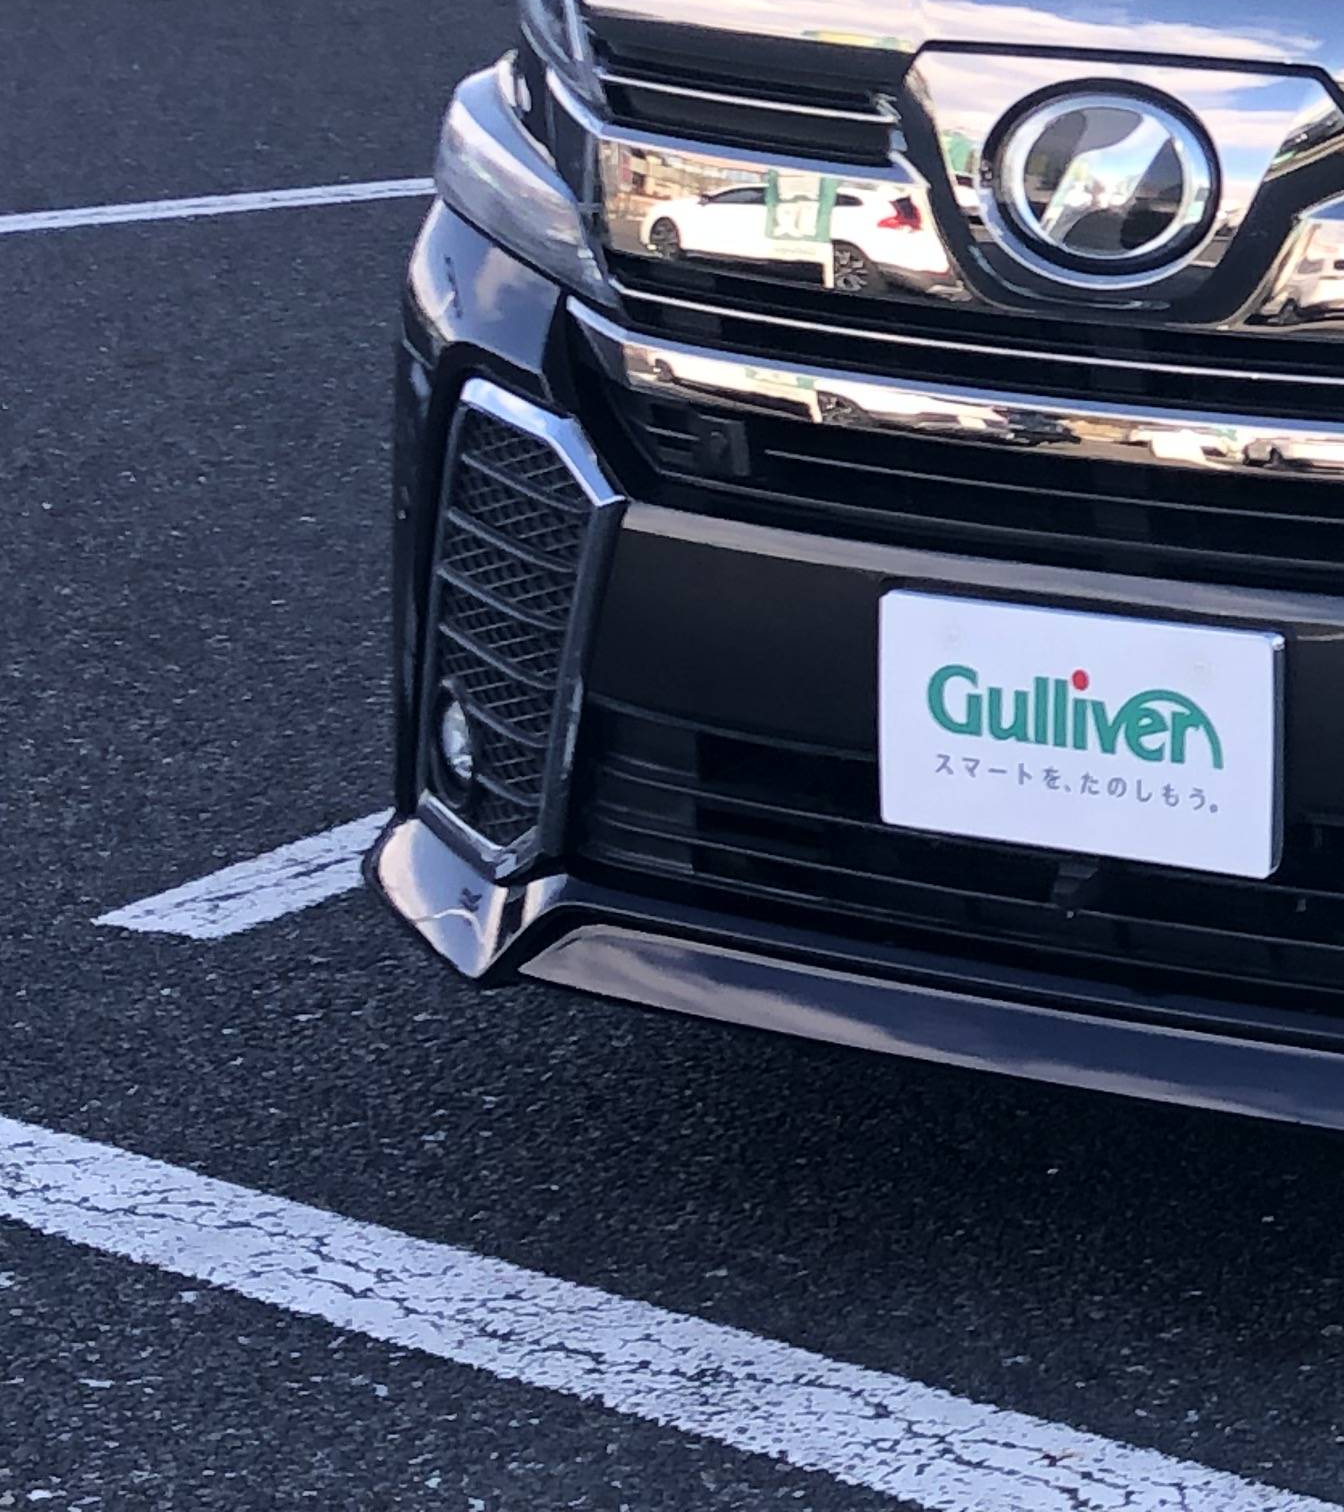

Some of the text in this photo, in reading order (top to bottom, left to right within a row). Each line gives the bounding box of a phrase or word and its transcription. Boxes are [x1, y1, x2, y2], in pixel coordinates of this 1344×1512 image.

[927, 663, 1224, 770] Gulliver
[934, 752, 1219, 813] スマートを、たのしもう。
